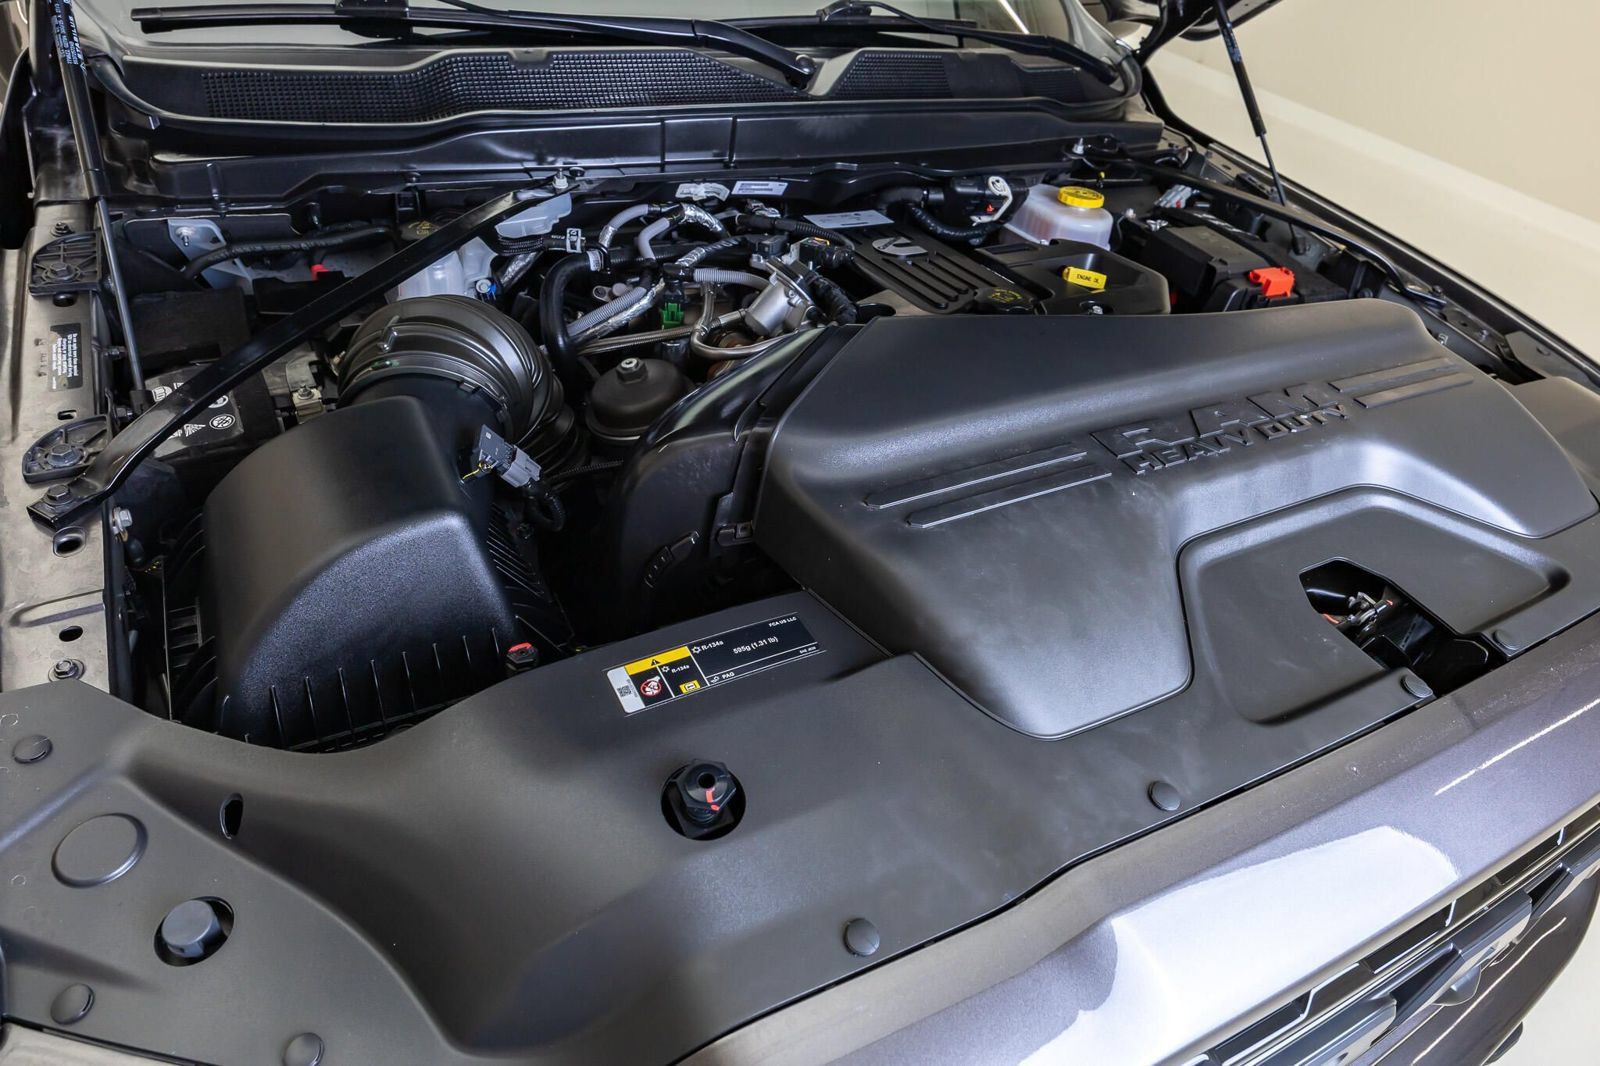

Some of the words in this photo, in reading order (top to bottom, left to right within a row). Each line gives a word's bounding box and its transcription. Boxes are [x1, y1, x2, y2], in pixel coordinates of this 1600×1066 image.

[1089, 382, 1340, 460] RAM
[1121, 427, 1255, 475] HEAVY
[1253, 403, 1350, 440] DUTY
[701, 640, 724, 651] R-134a
[721, 671, 735, 680] PAG
